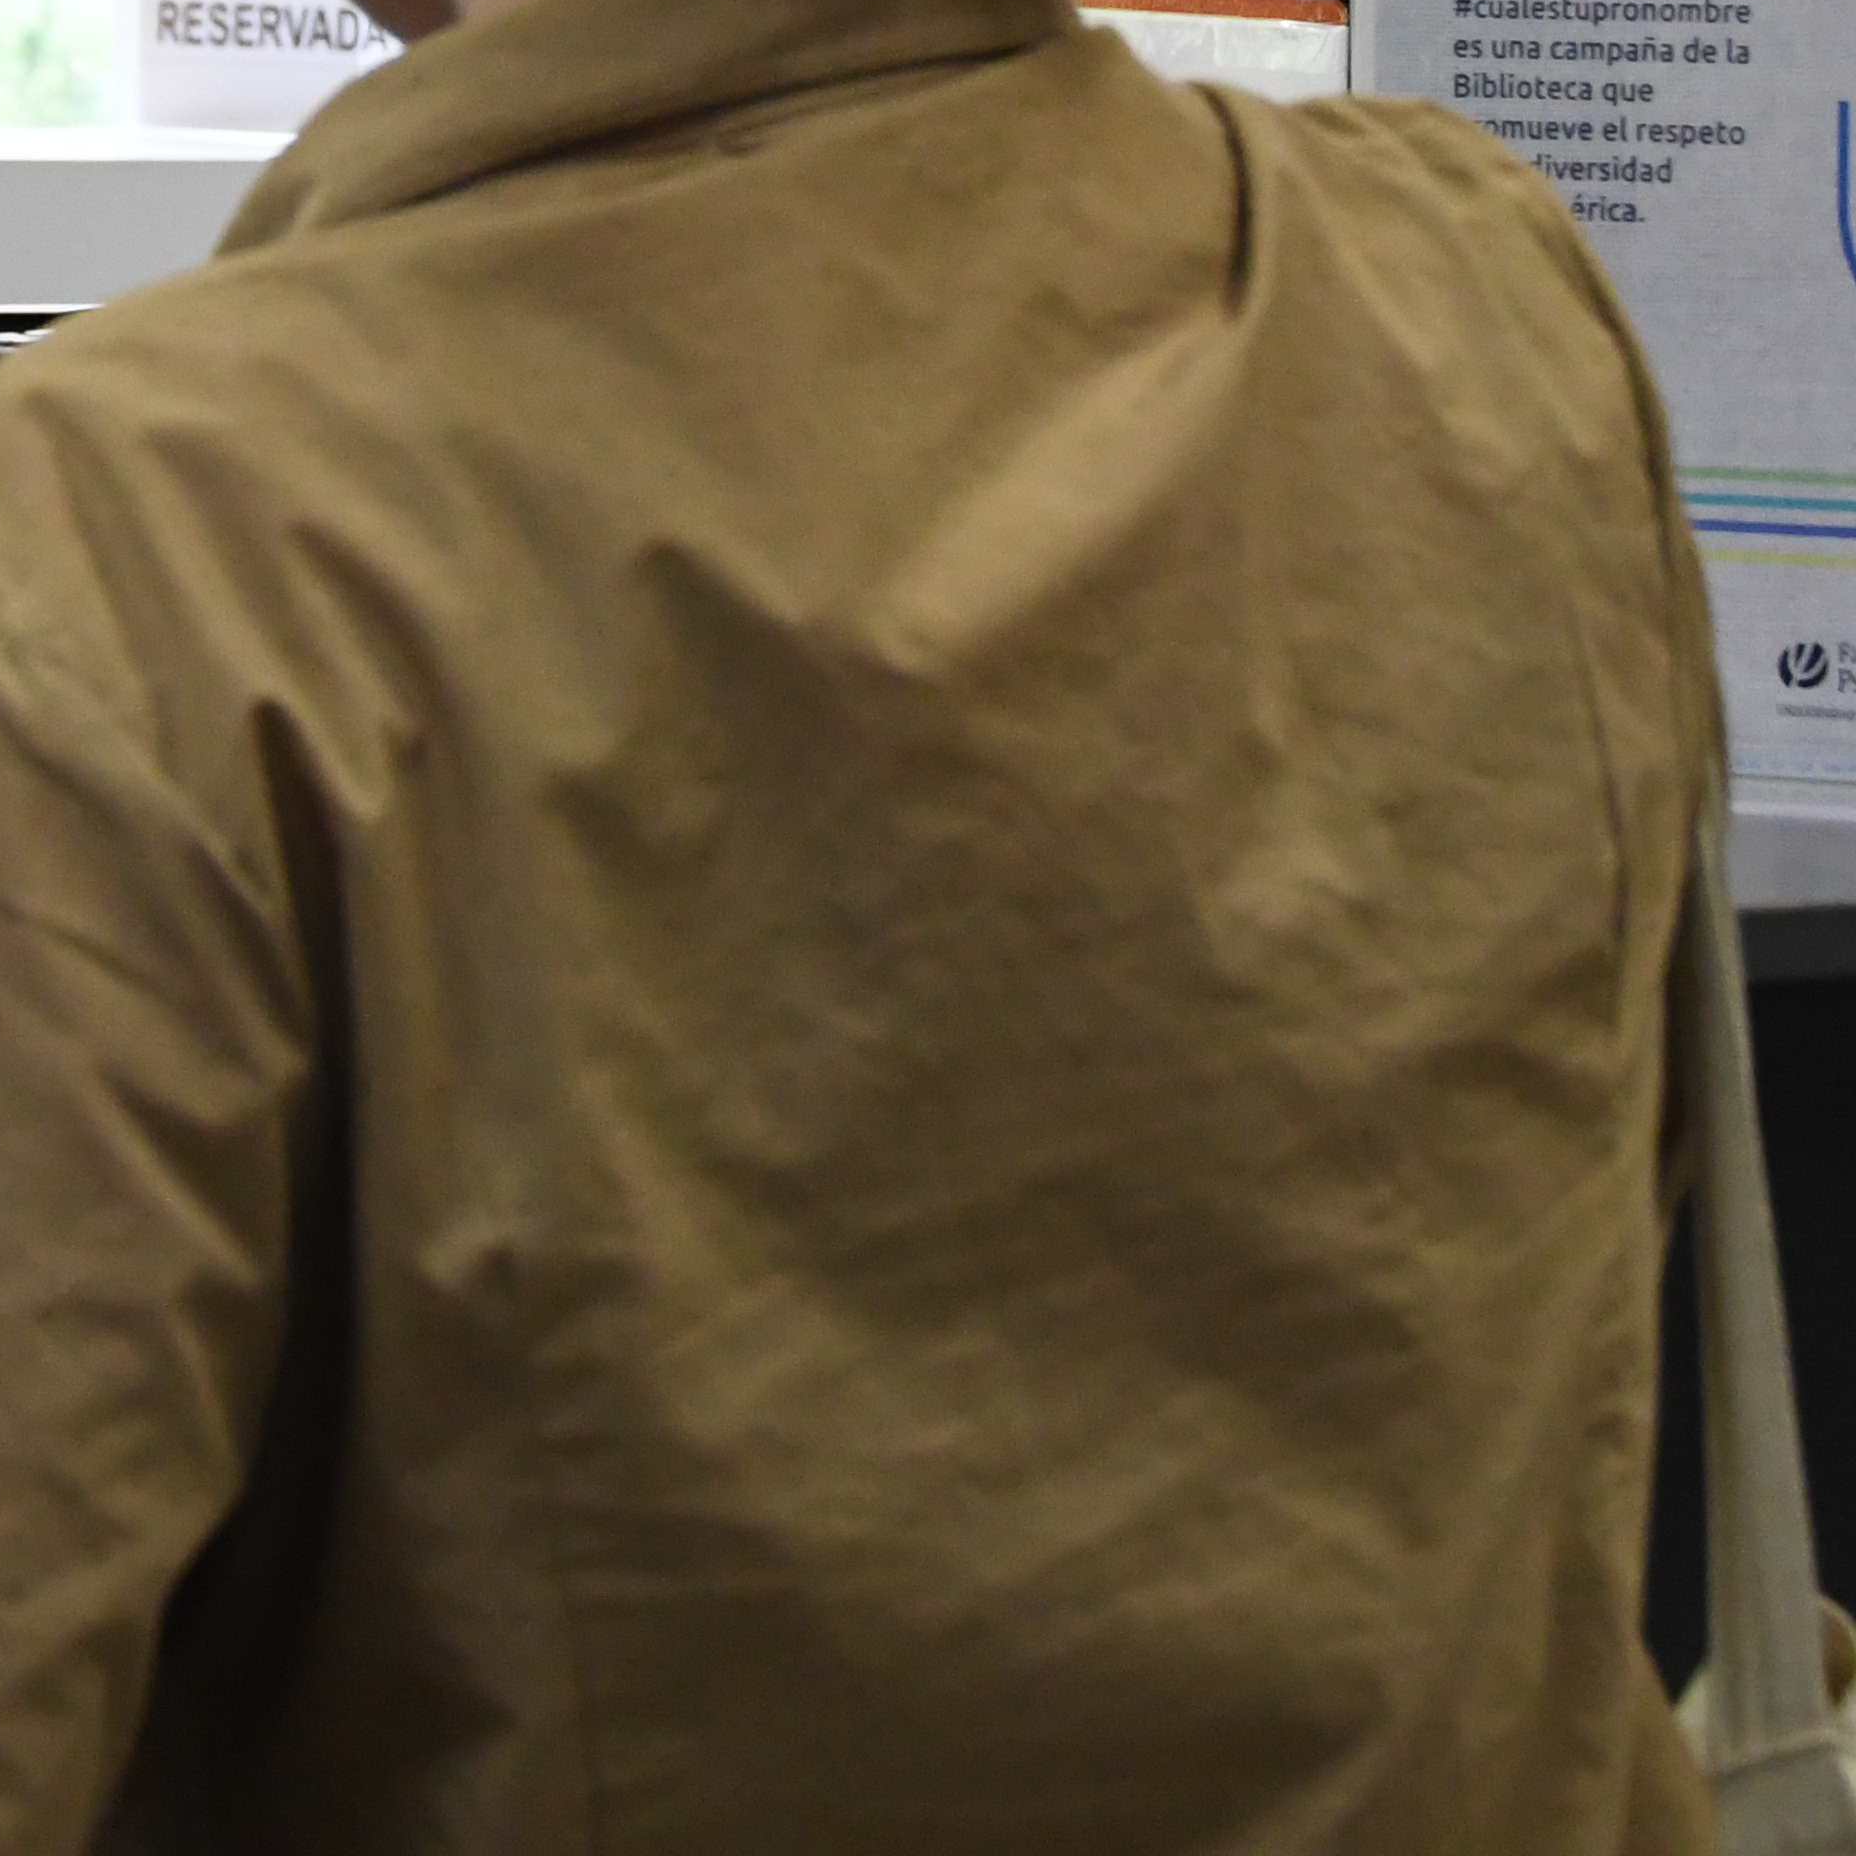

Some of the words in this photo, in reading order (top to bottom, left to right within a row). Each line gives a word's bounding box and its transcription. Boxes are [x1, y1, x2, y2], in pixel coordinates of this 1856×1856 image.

[1454, 39, 1482, 59] es
[1492, 39, 1541, 60] una
[1550, 37, 1674, 66] campaña
[1683, 38, 1717, 63] de
[1727, 38, 1750, 64] la
[1454, 72, 1593, 99] Biblioteca
[1602, 83, 1654, 106] que
[1474, 118, 1593, 142] omueve
[1603, 116, 1628, 142] el
[1636, 123, 1746, 148] respeto
